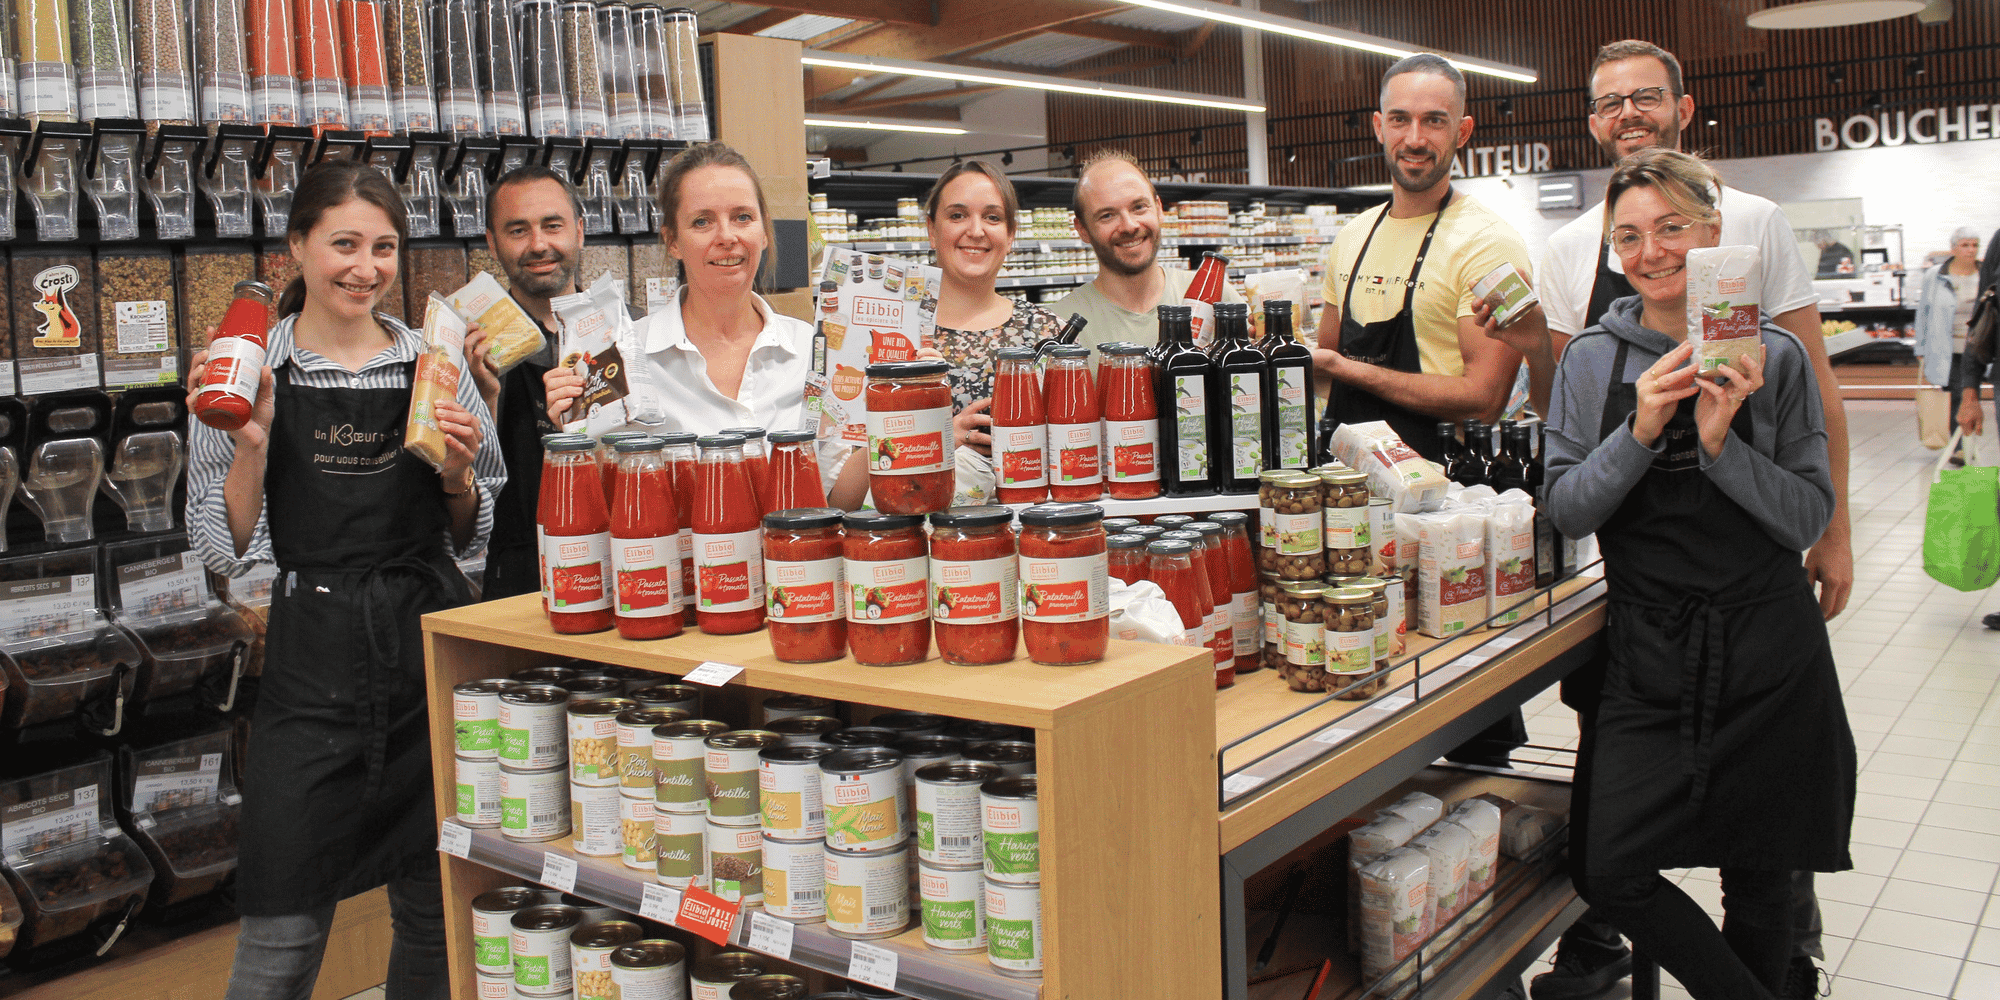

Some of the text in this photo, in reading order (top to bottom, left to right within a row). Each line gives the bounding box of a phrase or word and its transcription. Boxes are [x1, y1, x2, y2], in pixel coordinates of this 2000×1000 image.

[1449, 142, 1551, 178] AITEUR
[40, 273, 73, 289] Crosti
[1339, 273, 1371, 283] TOMY
[856, 299, 900, 317] Élibio
[882, 336, 906, 348] UNE BIO
[878, 347, 909, 360] DE QUALITÉ
[314, 429, 327, 440] Un
[896, 441, 940, 454] Ratatouille
[313, 453, 335, 463] pour
[336, 456, 359, 465] vous
[123, 556, 176, 574] CANNEBERGES
[144, 568, 158, 577] BIO
[573, 574, 601, 584] Passata
[718, 573, 748, 583] Passata
[10, 584, 35, 593] ABRICOTS
[36, 582, 50, 590] SECS
[75, 577, 90, 587] 137
[637, 578, 667, 588] Passata
[788, 591, 831, 604] Ratatouille
[886, 589, 925, 602] Ratatouille
[953, 592, 998, 605] Ratatouille
[1039, 589, 1085, 601] Ratatouille
[145, 756, 219, 768] CANNEBERGES 161
[629, 753, 648, 768] Pois
[163, 765, 175, 773] BIO
[624, 763, 655, 778] Chiche
[658, 771, 693, 787] Lentilles
[713, 783, 750, 799] Lentilles
[836, 786, 867, 798] Élibio
[7, 788, 96, 814] ABRICOTS SECS 137
[32, 806, 46, 816] BIO
[857, 810, 885, 825] Maïs
[54, 814, 74, 825] 13,20
[999, 838, 1038, 851] Harico
[658, 848, 691, 862] Lentilles
[1010, 850, 1035, 861] verts
[709, 906, 731, 921] PRIX
[931, 904, 973, 919] Haricots
[939, 918, 962, 929] verts
[991, 921, 1030, 939] Haricots
[998, 938, 1020, 950] verts
